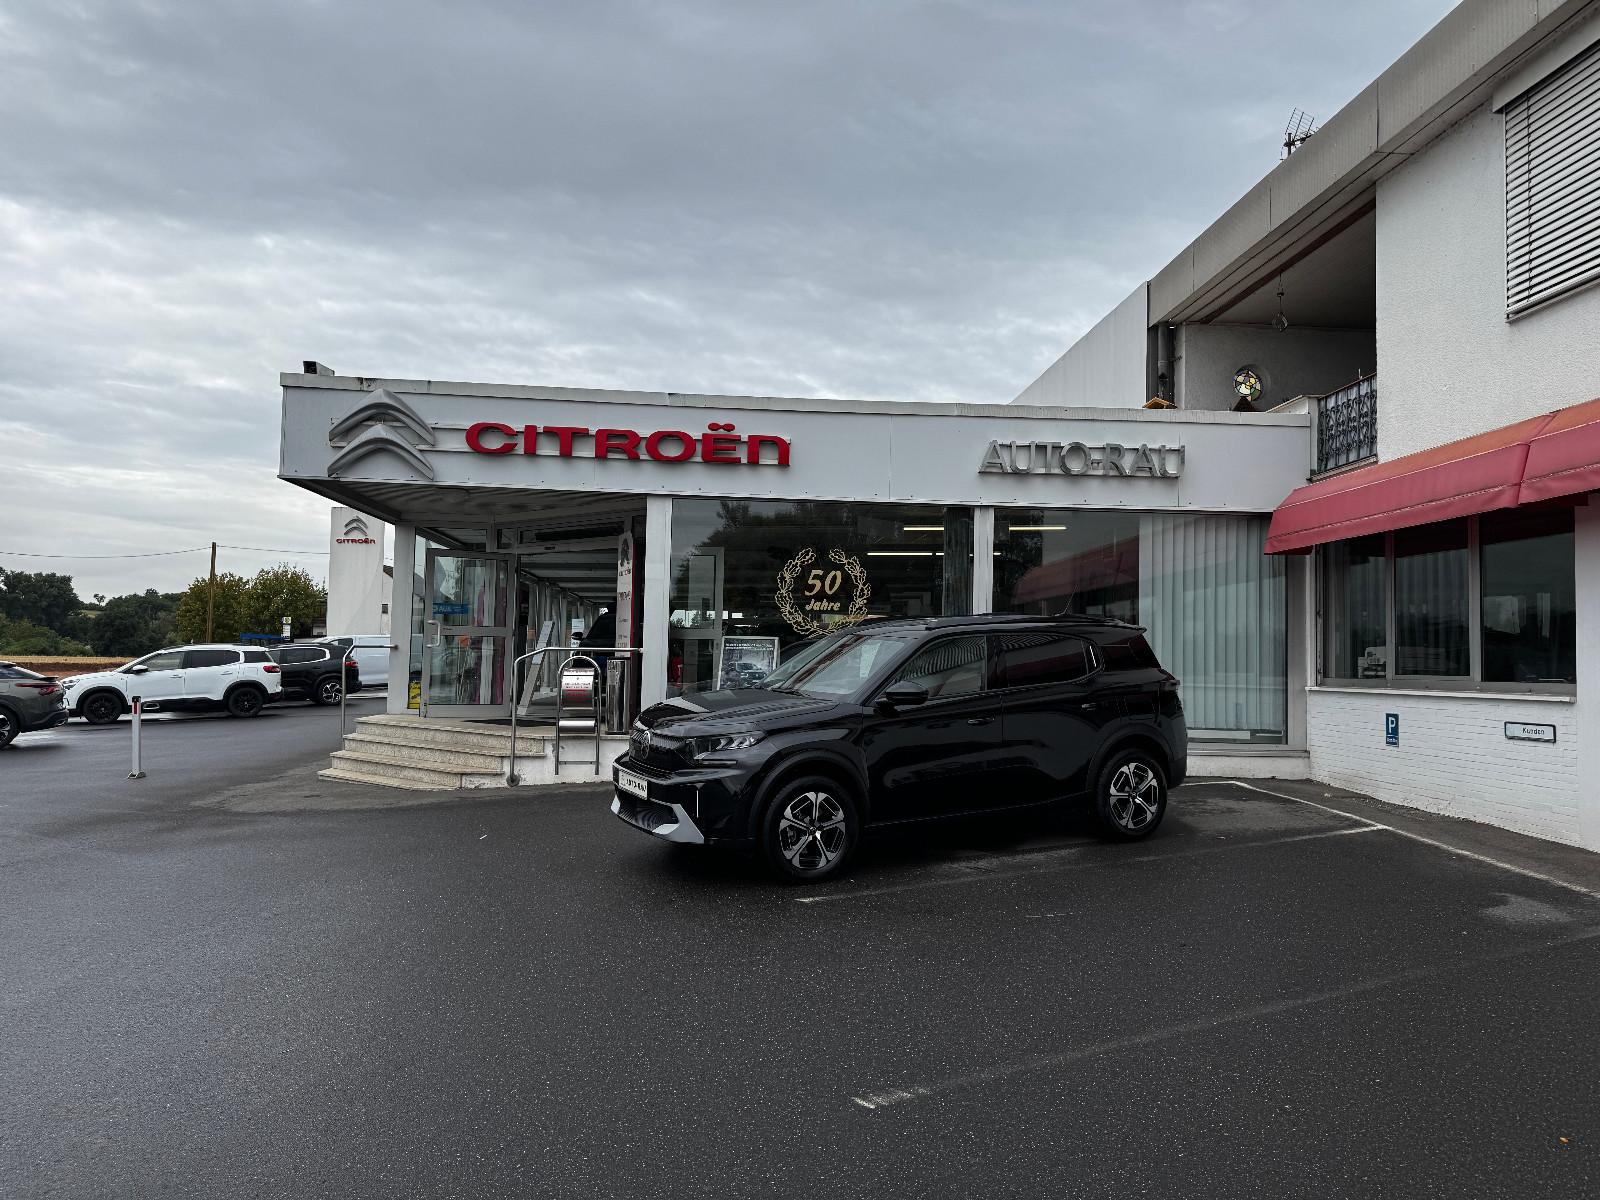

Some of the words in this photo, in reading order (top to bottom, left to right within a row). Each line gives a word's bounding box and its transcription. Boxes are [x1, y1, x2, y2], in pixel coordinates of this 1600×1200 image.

[804, 569, 842, 596] 50
[805, 598, 841, 611] Jahre
[1388, 716, 1396, 734] P
